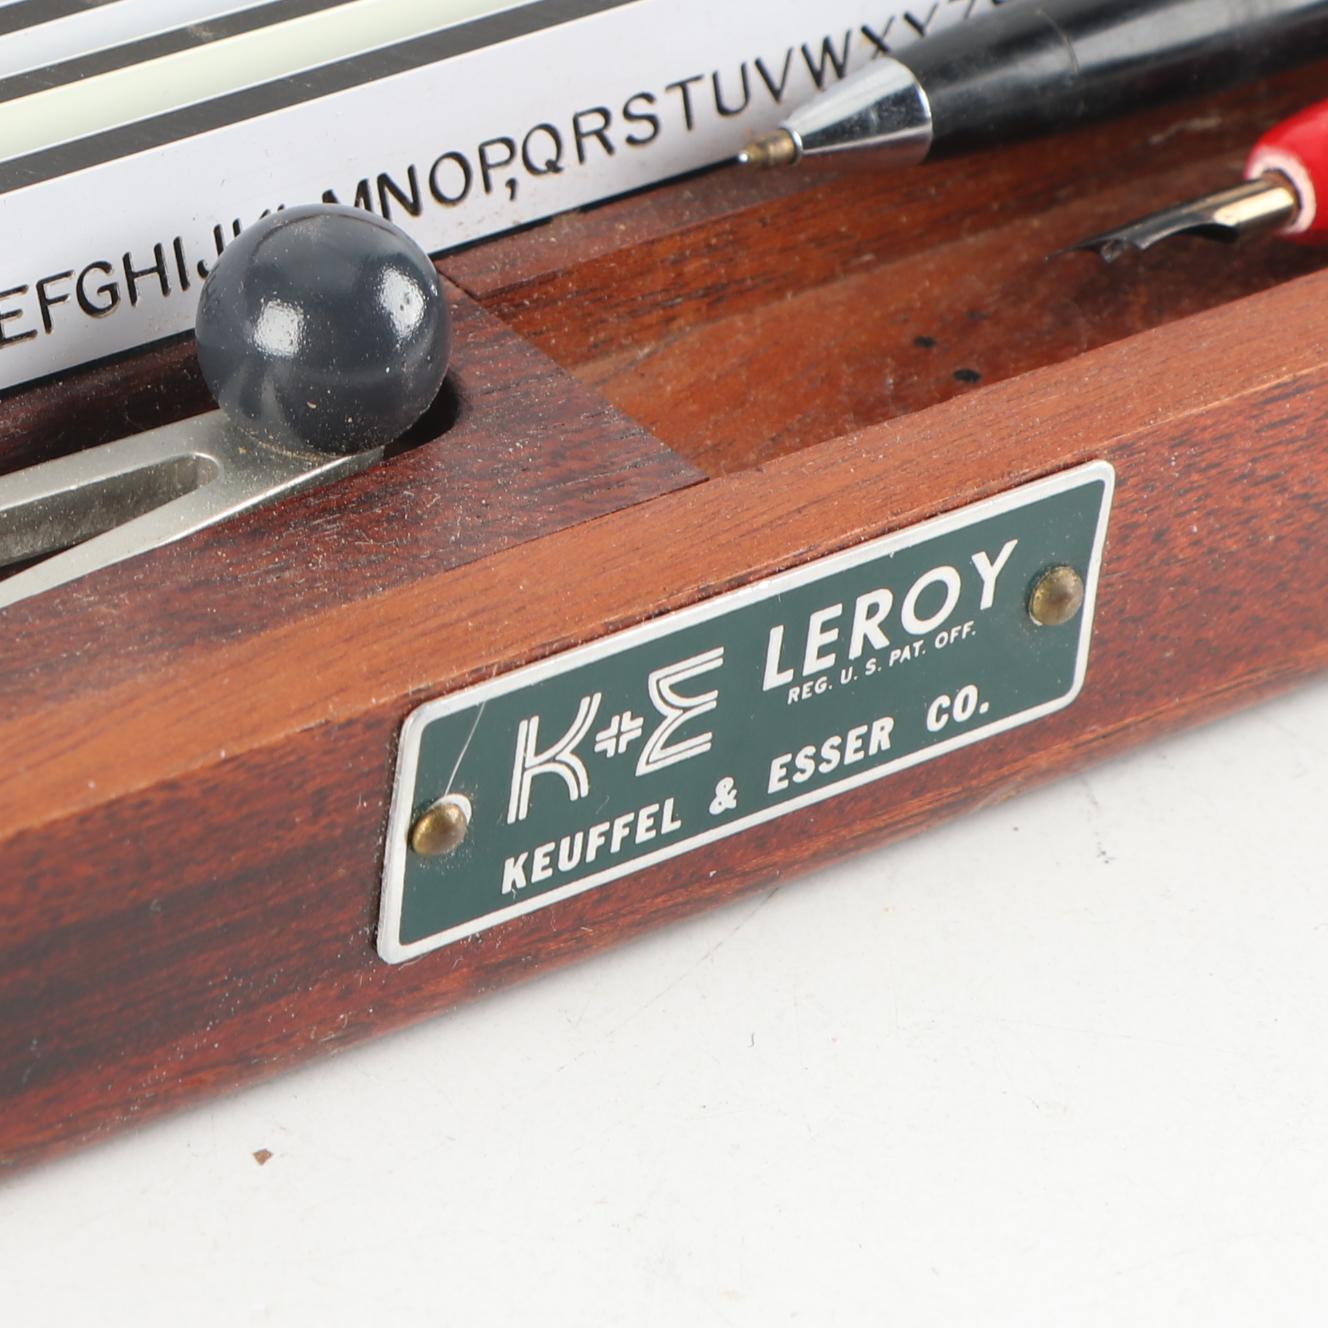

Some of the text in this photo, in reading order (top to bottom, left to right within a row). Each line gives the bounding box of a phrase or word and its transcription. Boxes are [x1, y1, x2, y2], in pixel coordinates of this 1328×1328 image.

[762, 538, 1020, 692] LEROY
[787, 675, 833, 705] REG.
[888, 638, 926, 668] PAT.
[934, 620, 977, 650] OFF.
[501, 684, 990, 896] KEUFFEL & ESSER CO.
